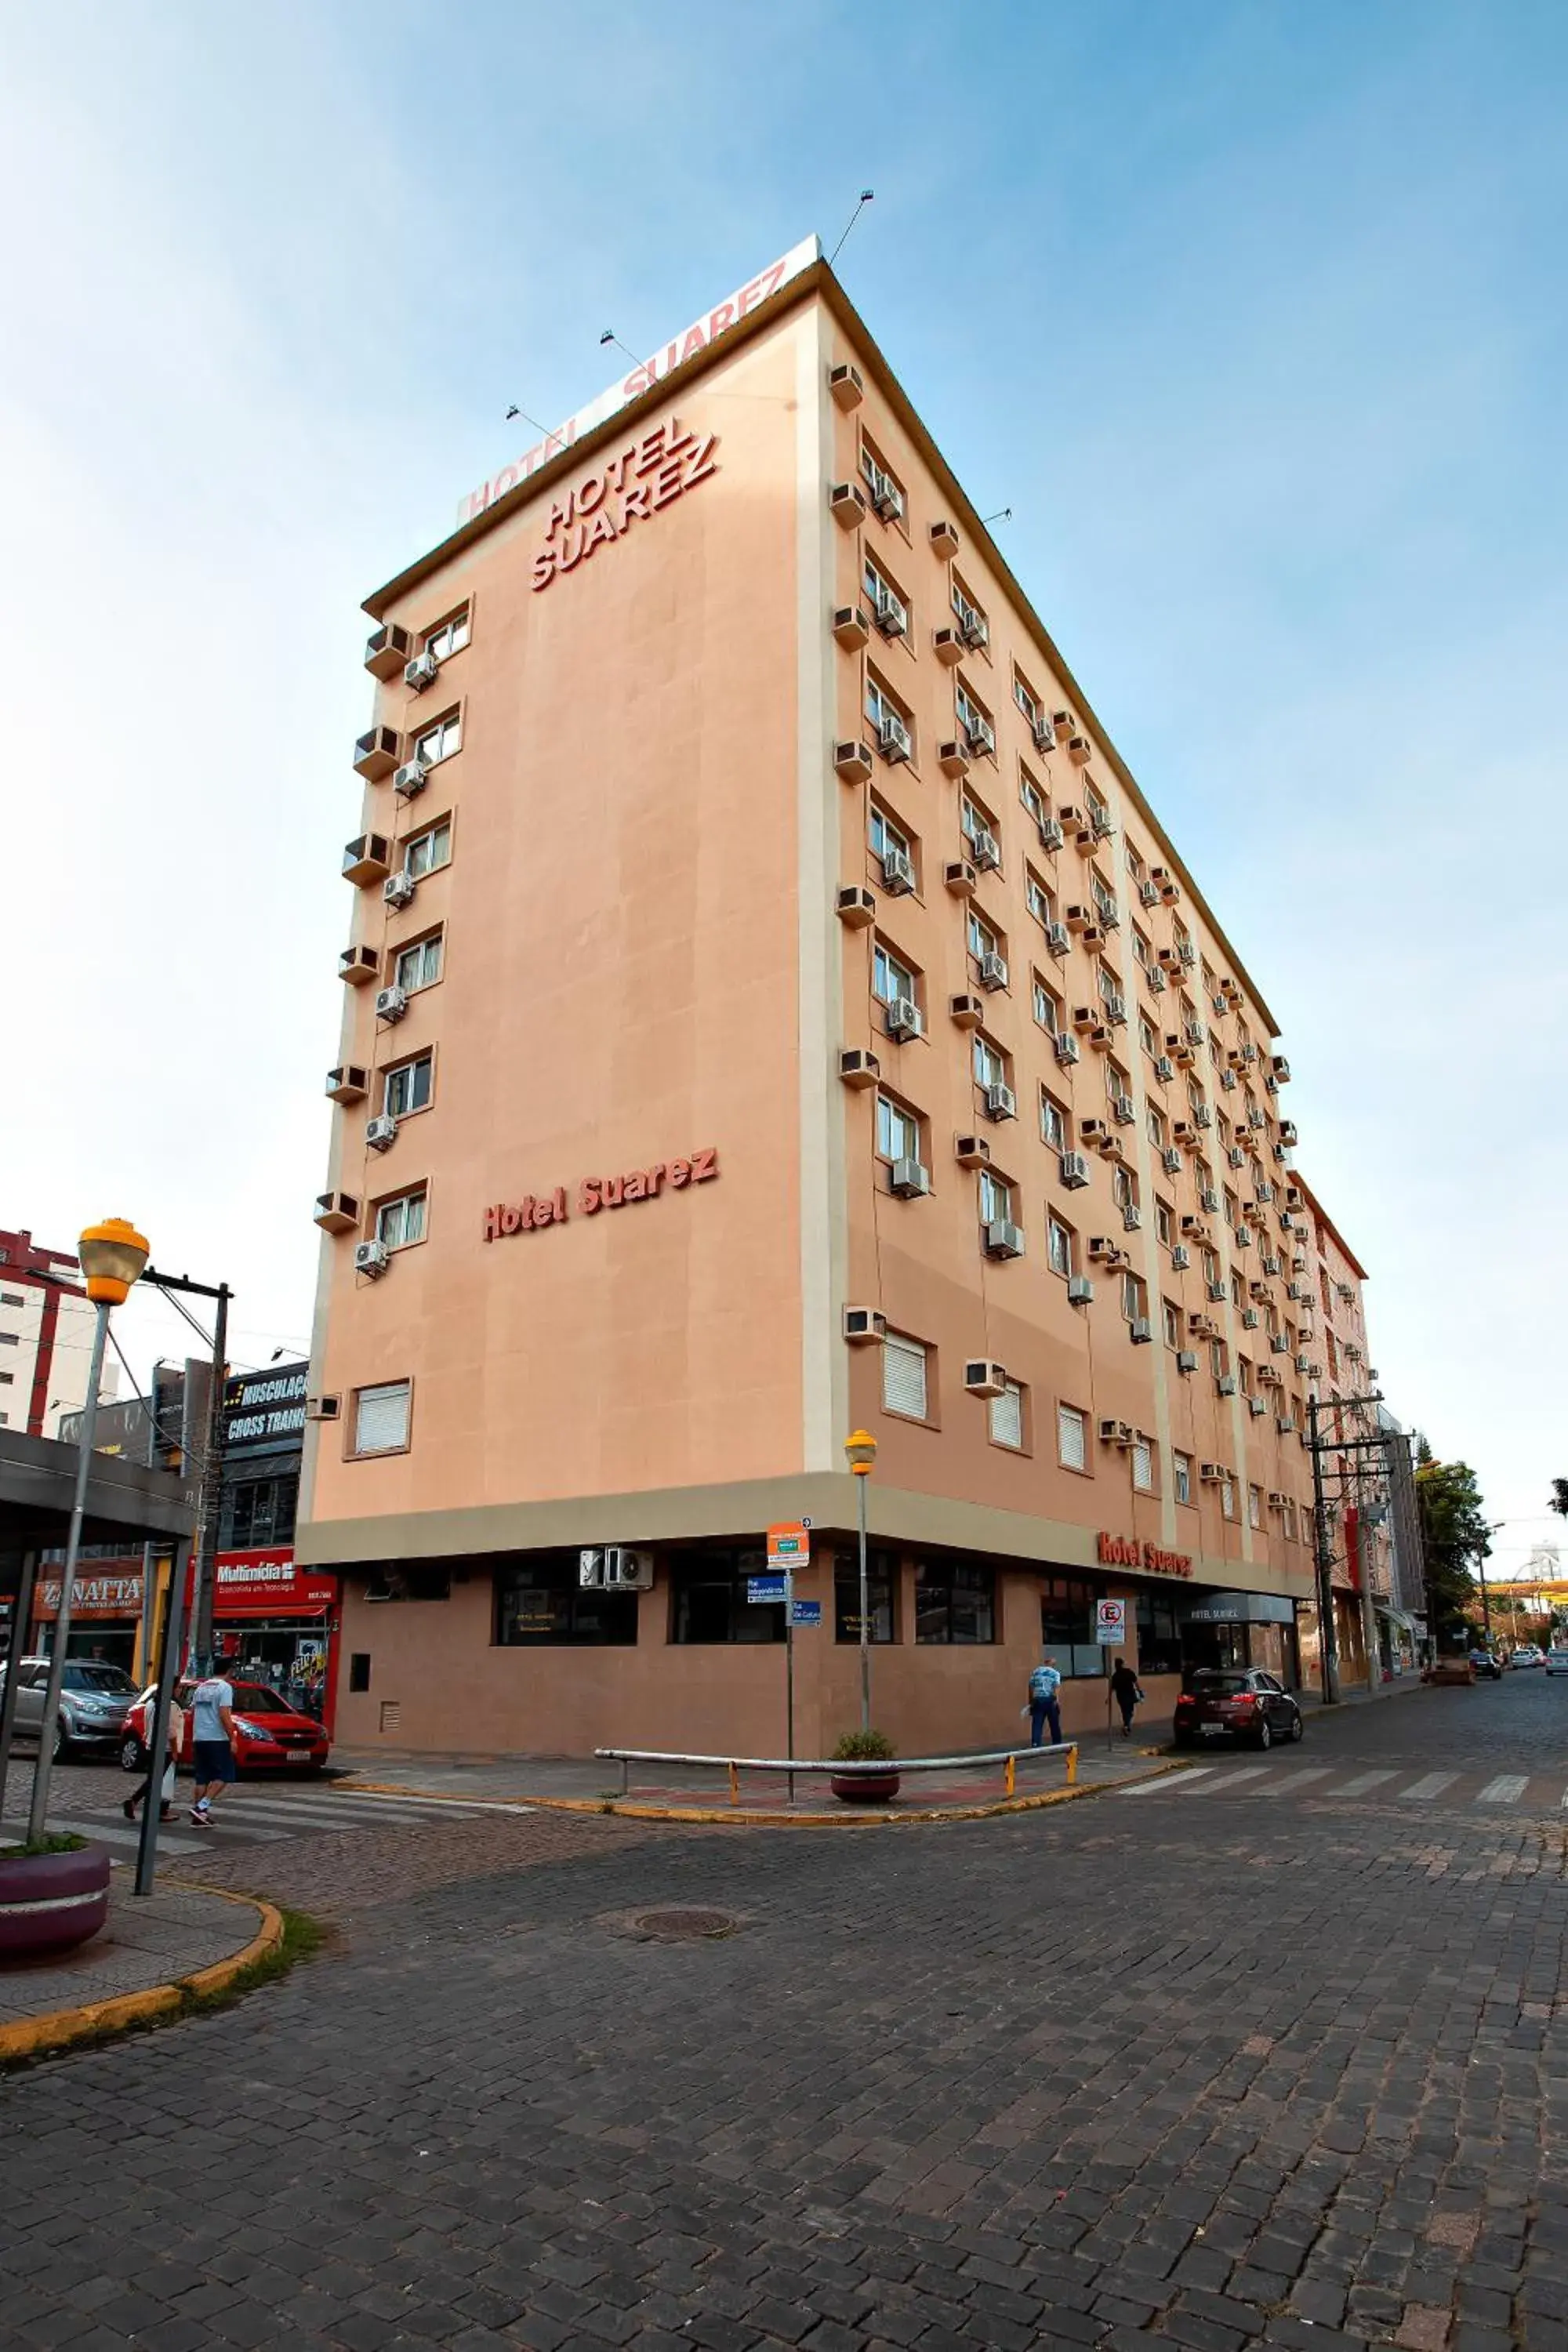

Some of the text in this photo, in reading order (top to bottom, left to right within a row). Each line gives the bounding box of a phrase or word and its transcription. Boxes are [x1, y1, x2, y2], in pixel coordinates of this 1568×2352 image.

[530, 431, 718, 593] SUAREZ
[546, 416, 698, 540] HOTEL
[483, 1148, 720, 1243] Hotel Suarez
[228, 1414, 266, 1440] CROSS
[218, 1562, 281, 1582] Multimídia
